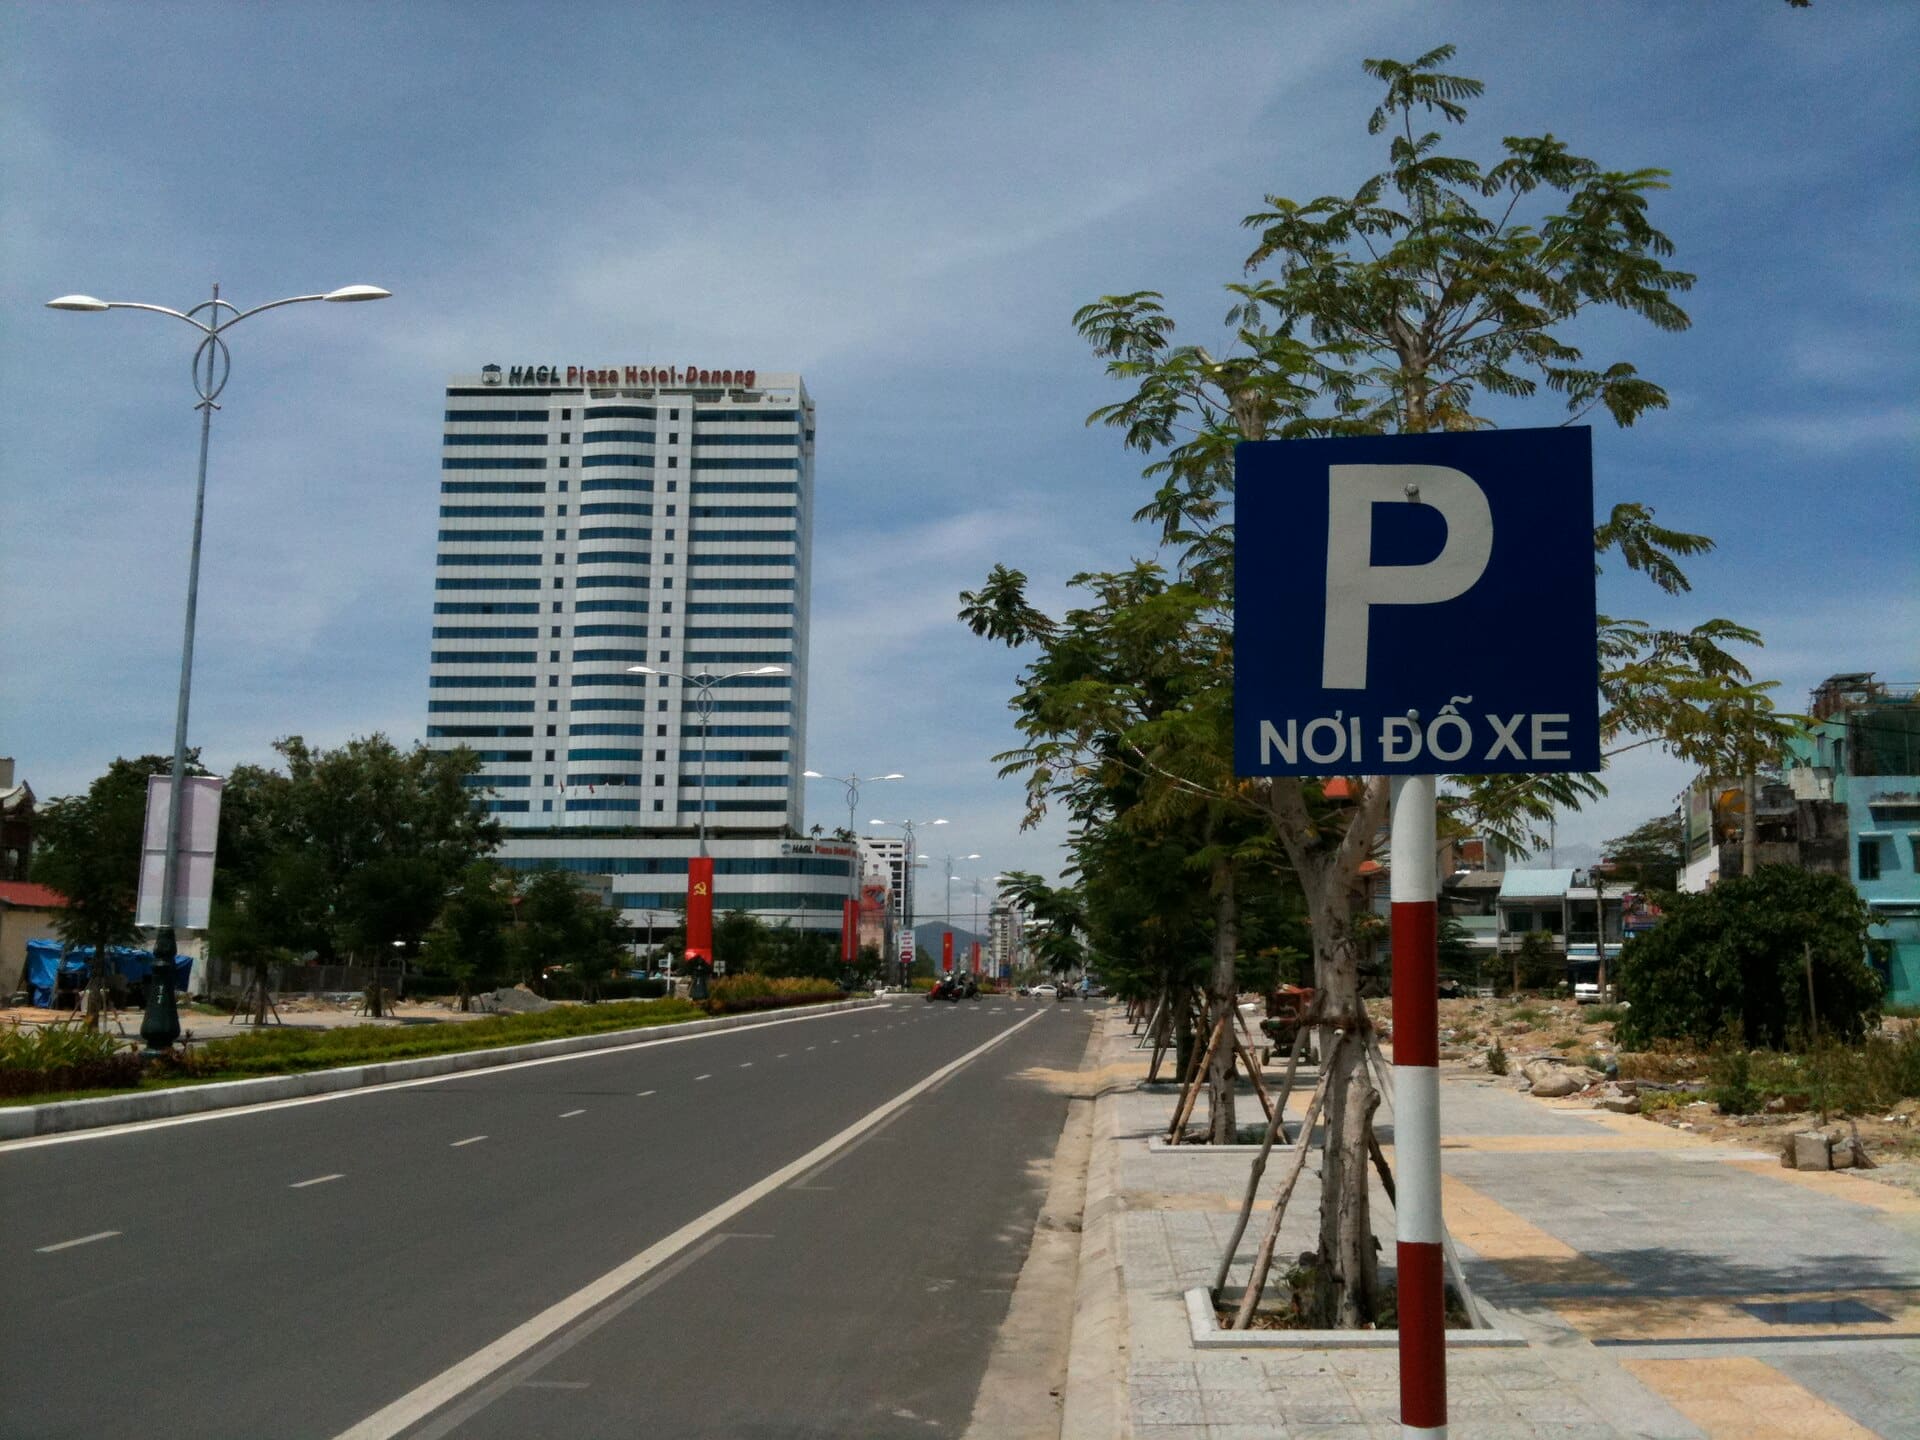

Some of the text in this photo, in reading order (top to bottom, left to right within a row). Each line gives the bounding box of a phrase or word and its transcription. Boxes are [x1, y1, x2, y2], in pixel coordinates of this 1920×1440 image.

[509, 365, 560, 386] HAGL
[566, 366, 619, 385] Plaza
[1322, 463, 1494, 690] P
[1260, 695, 1571, 765] NƠI ĐỖ XE
